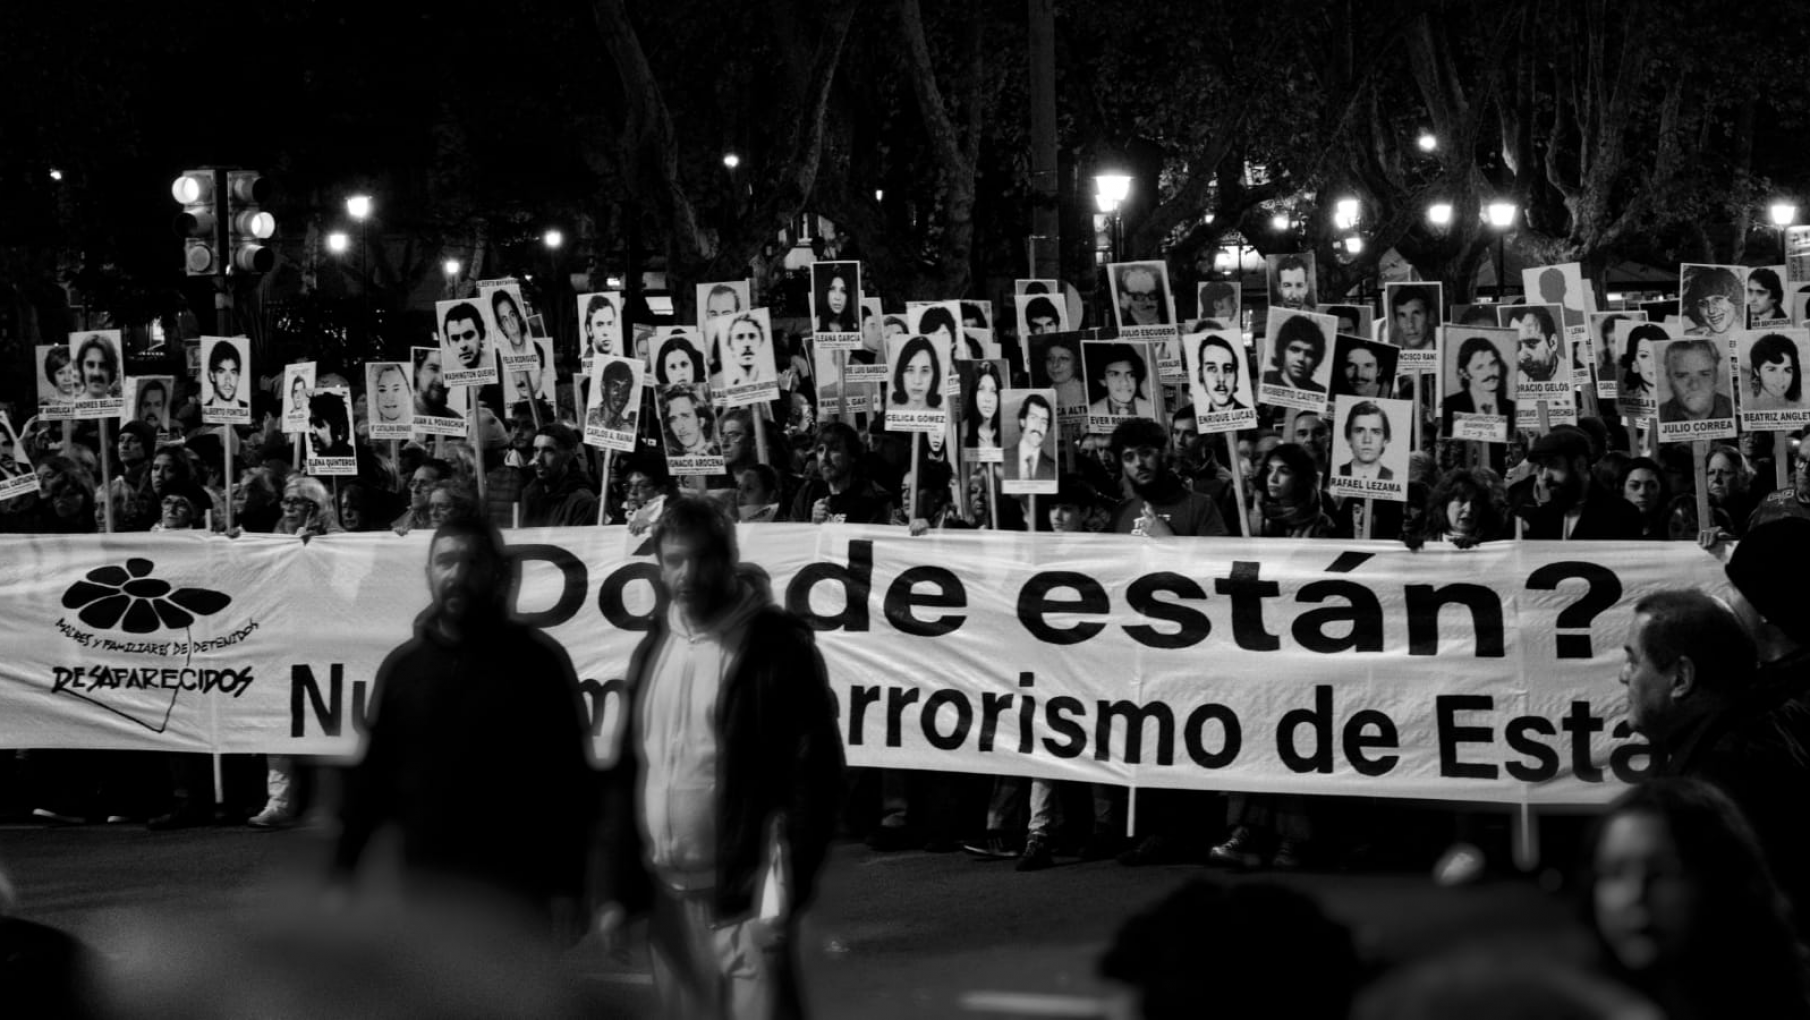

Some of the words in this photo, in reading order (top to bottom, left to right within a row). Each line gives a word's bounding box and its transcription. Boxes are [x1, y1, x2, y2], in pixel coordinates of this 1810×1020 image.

[1121, 329, 1139, 337] JULIO
[1141, 328, 1175, 336] ESCUDERO
[1544, 383, 1570, 391] GELOS
[886, 414, 915, 422] CELICA
[1090, 416, 1109, 424] EVER
[1198, 413, 1230, 425] ENRIQUE
[1231, 410, 1254, 421] LUCAS
[1744, 412, 1778, 422] BEATRIZ
[1662, 425, 1691, 434] JULIO
[1693, 421, 1733, 431] CORREA
[327, 458, 356, 467] QUINTEROS
[695, 459, 724, 467] AROCENA
[1331, 477, 1364, 489] RAFAEL
[1366, 482, 1402, 492] LEZAMA
[506, 537, 967, 638] Dóde
[102, 639, 172, 656] FAMILIARES
[173, 645, 189, 656] DE
[193, 617, 259, 654] DETENIDOS
[52, 665, 253, 698] DESAPARECIDOS
[848, 672, 1242, 769] rrorismo
[1276, 685, 1399, 777] de
[1437, 695, 1652, 784] Esta
